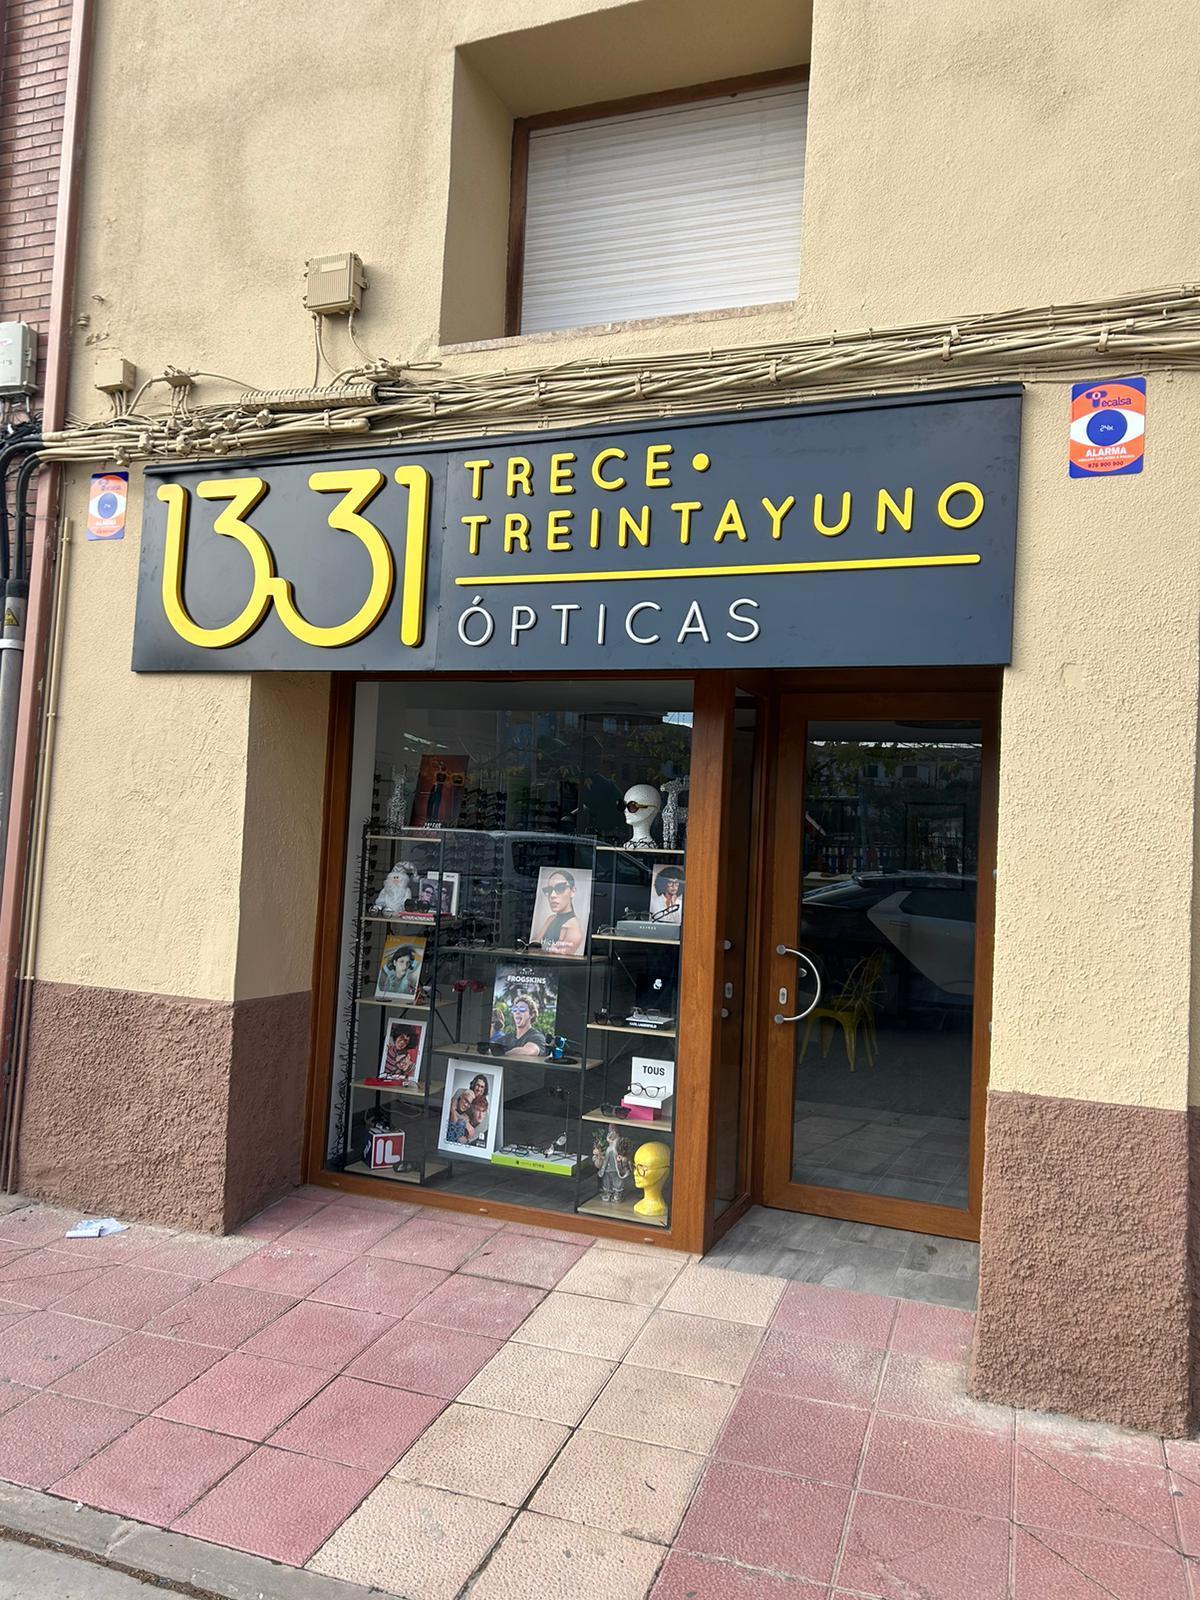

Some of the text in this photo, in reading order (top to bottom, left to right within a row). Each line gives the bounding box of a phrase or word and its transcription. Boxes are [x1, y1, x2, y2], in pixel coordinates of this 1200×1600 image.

[1086, 446, 1127, 457] ALARMA
[464, 444, 673, 500] TRECE
[461, 481, 985, 555] TREINTAYUNO
[458, 595, 760, 647] ÓPTICAS
[507, 975, 547, 984] FROGSKINS
[643, 1065, 665, 1076] TOUS
